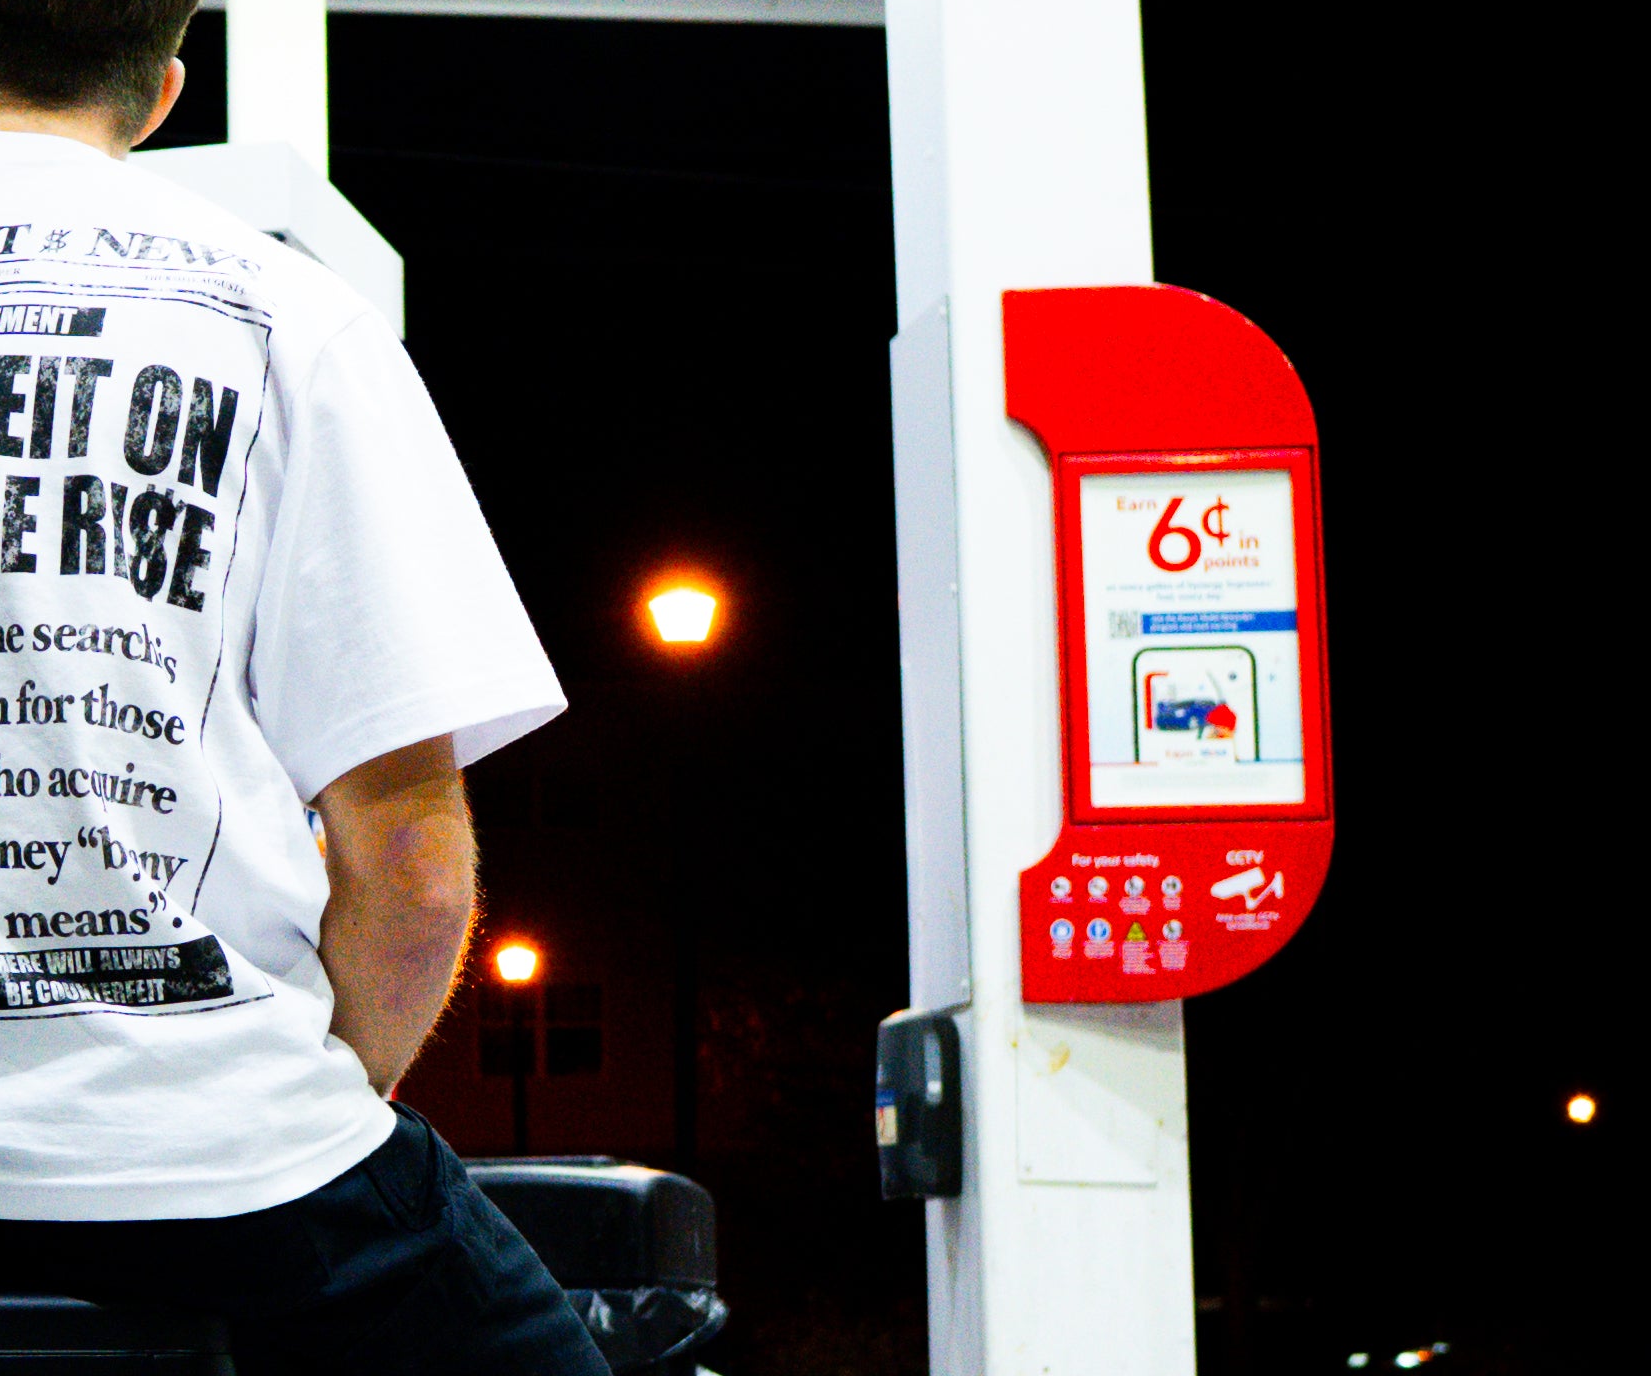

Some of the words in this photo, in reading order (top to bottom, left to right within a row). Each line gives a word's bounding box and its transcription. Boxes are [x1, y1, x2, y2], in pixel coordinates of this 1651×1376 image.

[123, 364, 239, 498] ON
[1116, 496, 1157, 512] Earn
[1239, 530, 1260, 550] in
[1204, 553, 1260, 572] points
[16, 680, 75, 725] for
[81, 683, 185, 746] those
[48, 762, 177, 815] acquire
[1226, 849, 1264, 866] CCTV
[46, 949, 93, 973] WILL
[100, 947, 181, 971] ALWAYS
[6, 979, 34, 1007] BE
[35, 977, 166, 1003] COUNTERFEIT
